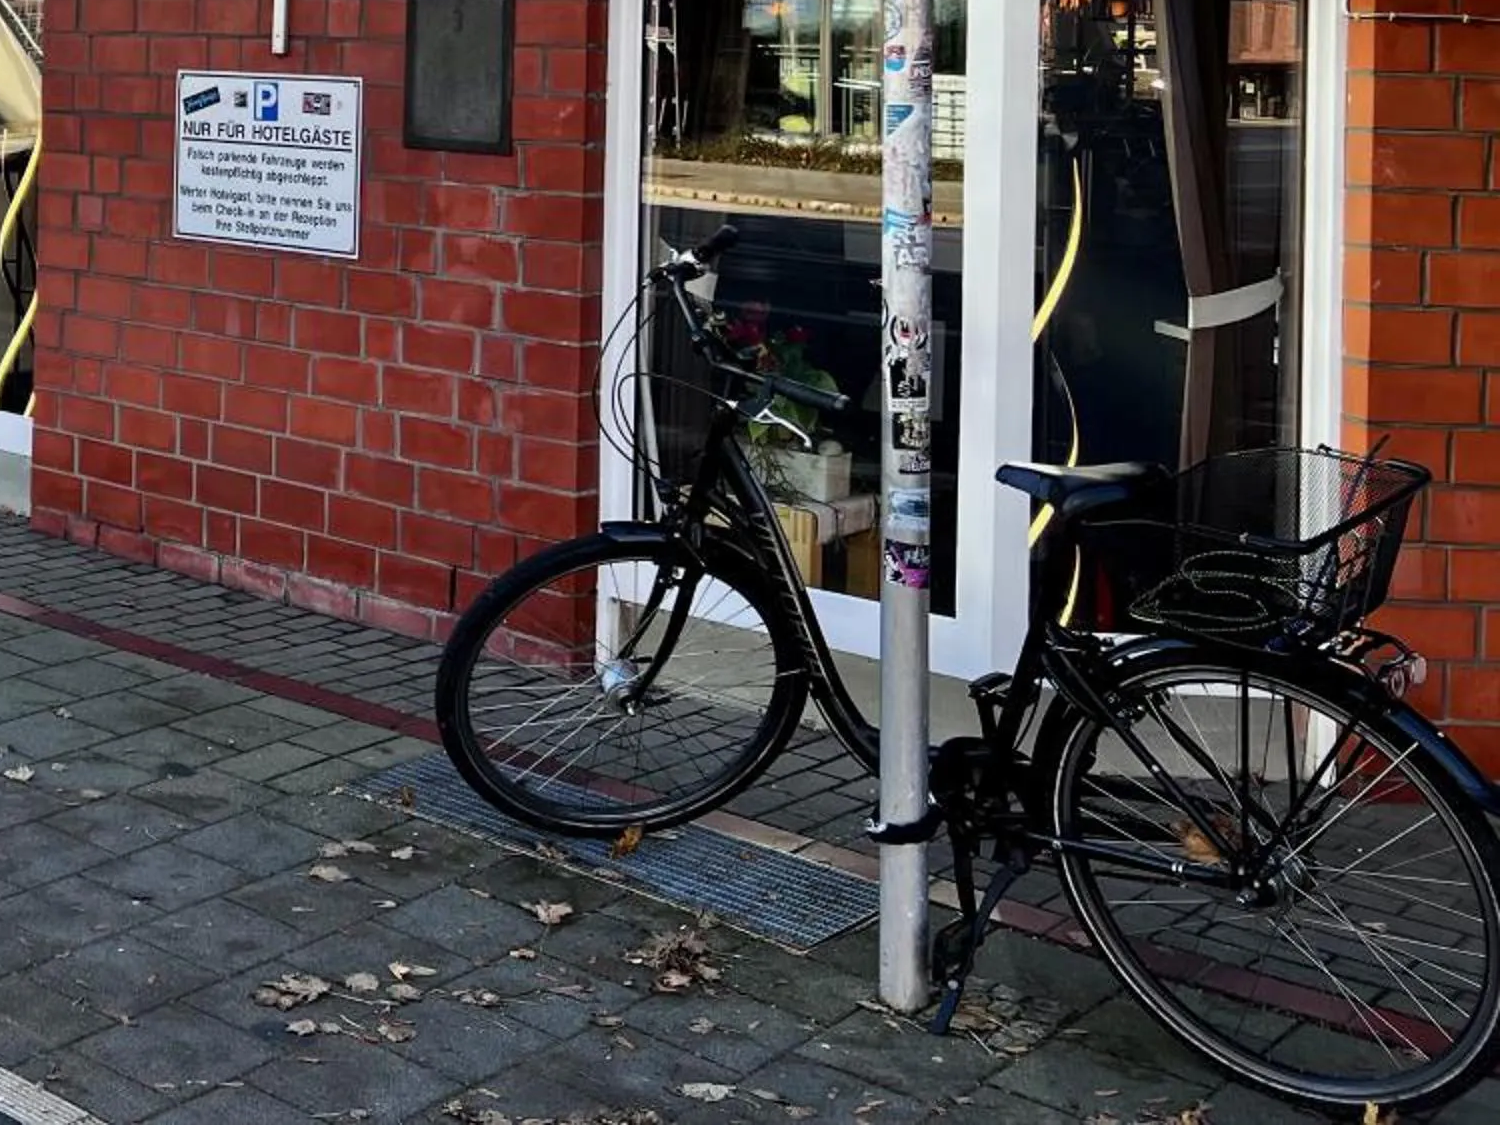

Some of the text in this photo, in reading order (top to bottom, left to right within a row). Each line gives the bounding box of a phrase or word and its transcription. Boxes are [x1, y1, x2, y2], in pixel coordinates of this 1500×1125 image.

[183, 121, 351, 146] NUR FÜR HOTELGÄSTE
